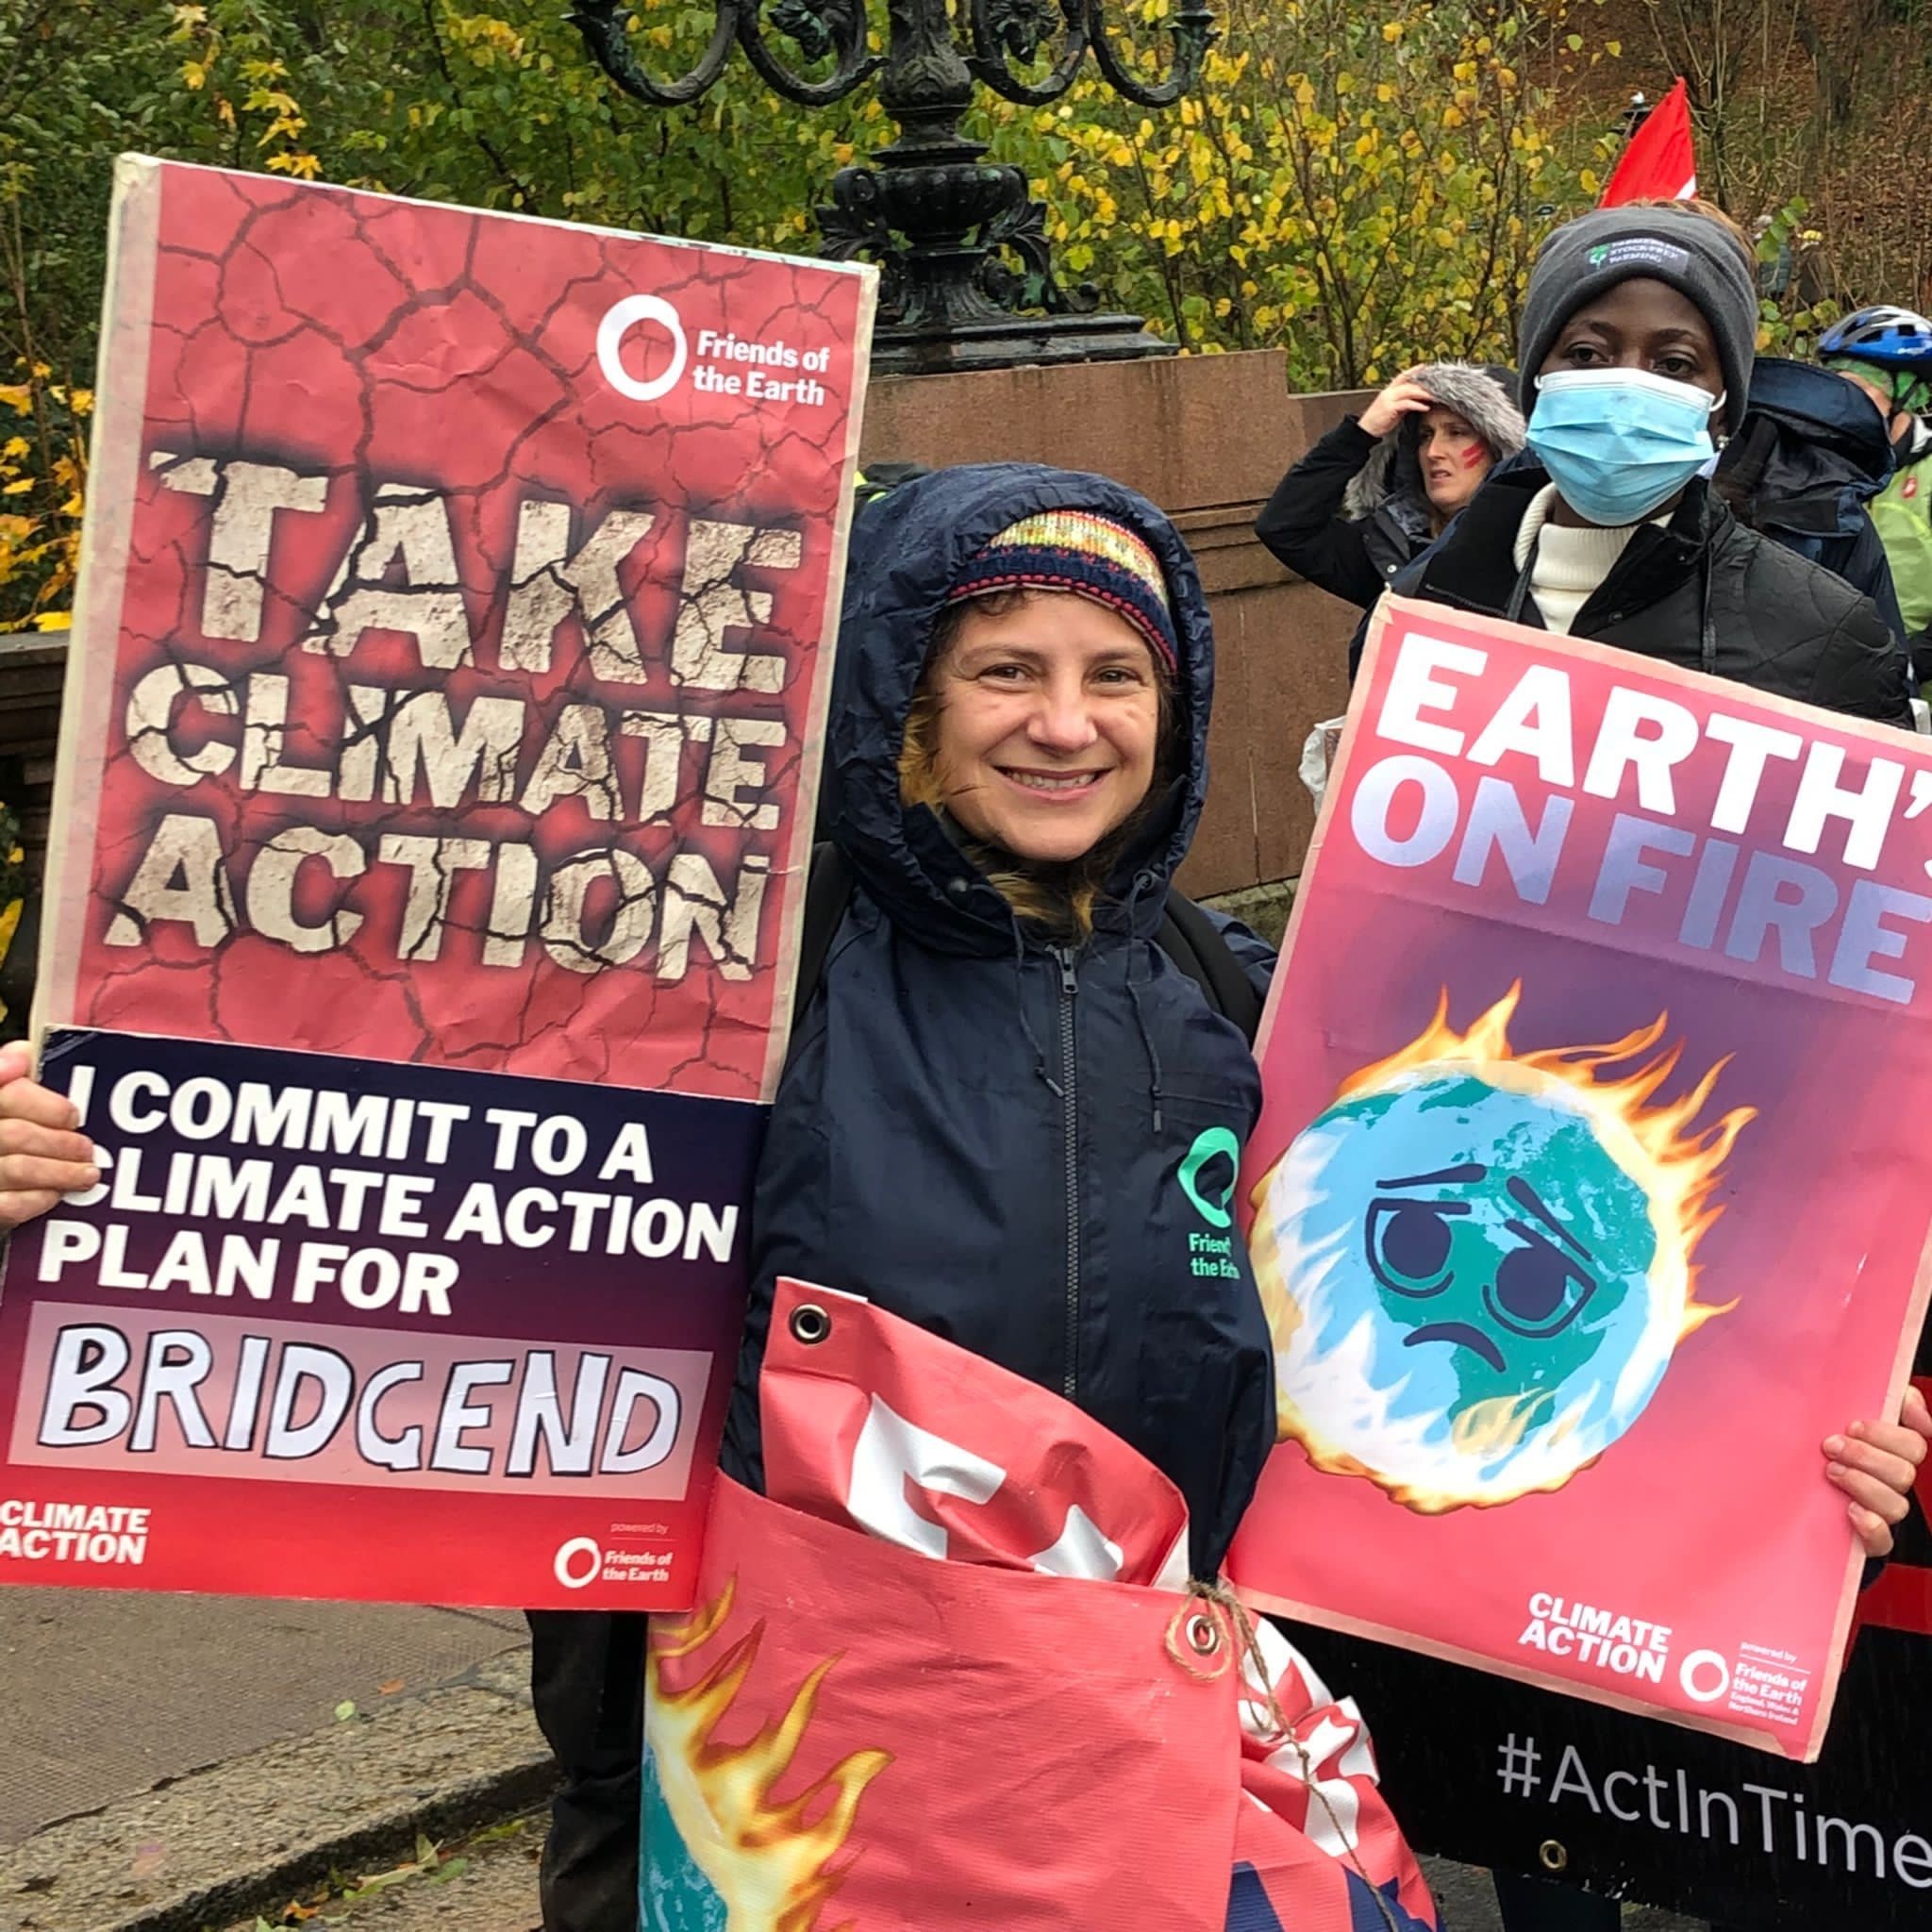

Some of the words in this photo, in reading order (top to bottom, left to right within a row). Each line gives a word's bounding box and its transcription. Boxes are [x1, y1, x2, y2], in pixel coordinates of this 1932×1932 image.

[696, 329, 798, 368] Friends
[802, 346, 830, 373] of
[692, 365, 741, 394] the
[745, 371, 825, 407] Earth
[148, 451, 802, 692] TAKE
[126, 662, 788, 830] CLIMATE
[1376, 632, 1932, 878] EARTH'
[104, 814, 769, 983] ACTION
[1351, 755, 1574, 905] ON
[1588, 812, 1932, 1005] FIRE
[68, 1065, 96, 1127] I
[109, 1070, 471, 1165] COMMIT
[485, 1108, 588, 1176] TO
[597, 1122, 654, 1184] A
[442, 1182, 740, 1263] ACTION
[38, 1219, 280, 1300] PLAN
[291, 1241, 459, 1316] FOR
[1191, 1257, 1219, 1276] the
[37, 1323, 683, 1478] BRIDGEND
[0, 1500, 152, 1534] CLIMATE
[0, 1527, 147, 1565] ACTION
[610, 1523, 656, 1534] powered
[657, 1523, 669, 1536] by
[602, 1567, 627, 1581] the
[627, 1567, 670, 1582] Earth
[605, 1550, 656, 1565] Friends
[657, 1551, 674, 1566] of
[1517, 1618, 1667, 1684] ACTION
[1528, 1591, 1673, 1653] CLIMATE
[1733, 1677, 1758, 1695] the
[1759, 1683, 1803, 1707] Earth
[1735, 1662, 1790, 1688] Friends
[1790, 1678, 1807, 1691] of
[1497, 1732, 1932, 1889] #ActInTime
